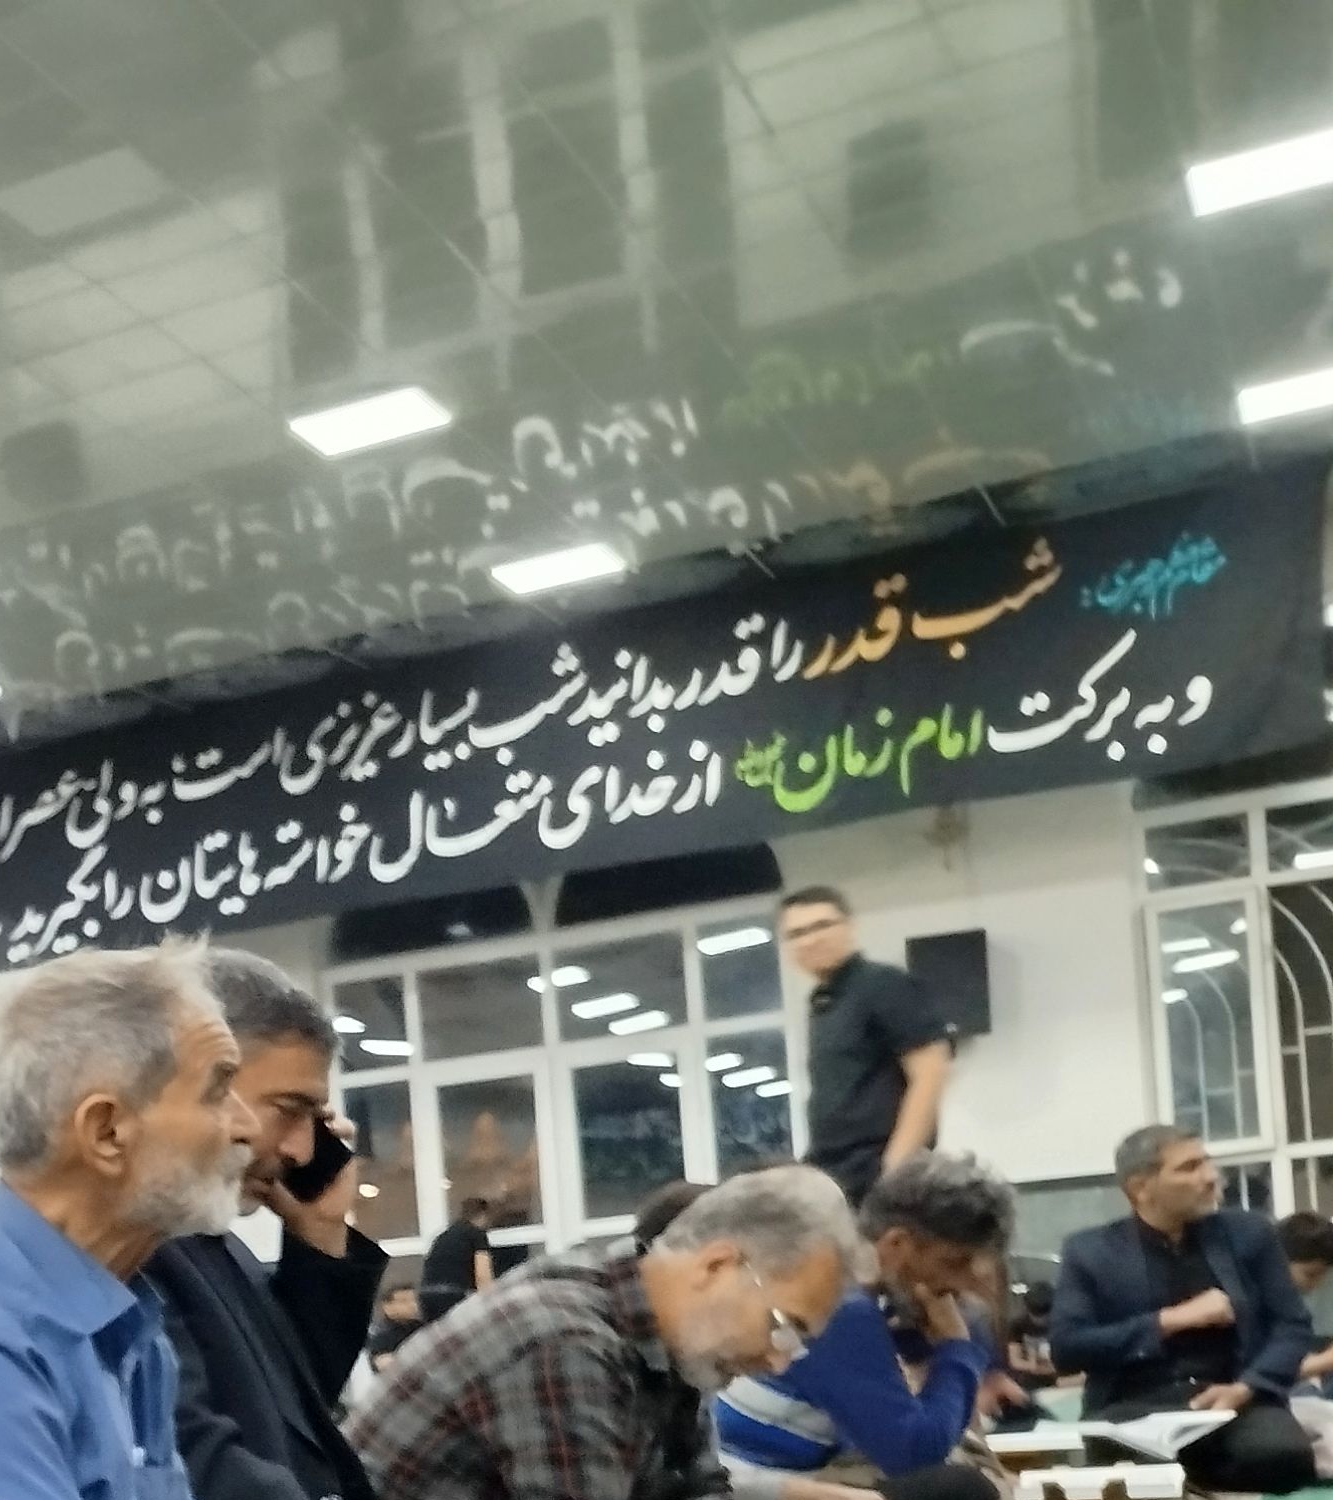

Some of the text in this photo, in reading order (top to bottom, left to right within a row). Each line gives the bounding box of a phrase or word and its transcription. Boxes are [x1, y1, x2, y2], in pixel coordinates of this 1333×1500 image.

[803, 573, 908, 680] قدر
[912, 538, 1062, 660] شب
[674, 613, 766, 711] قدر
[771, 617, 804, 682] را
[988, 627, 1137, 762] برکت
[279, 691, 403, 795] عزیزی
[387, 688, 479, 772] بسیار
[468, 641, 587, 767] شب
[1134, 694, 1175, 756] به
[1177, 674, 1213, 726] و
[672, 739, 723, 815] از
[773, 706, 895, 814] زمان
[900, 702, 983, 798] امام
[139, 780, 166, 826] به
[368, 769, 554, 885] متعال
[537, 749, 679, 851] خدای
[104, 867, 136, 921] را
